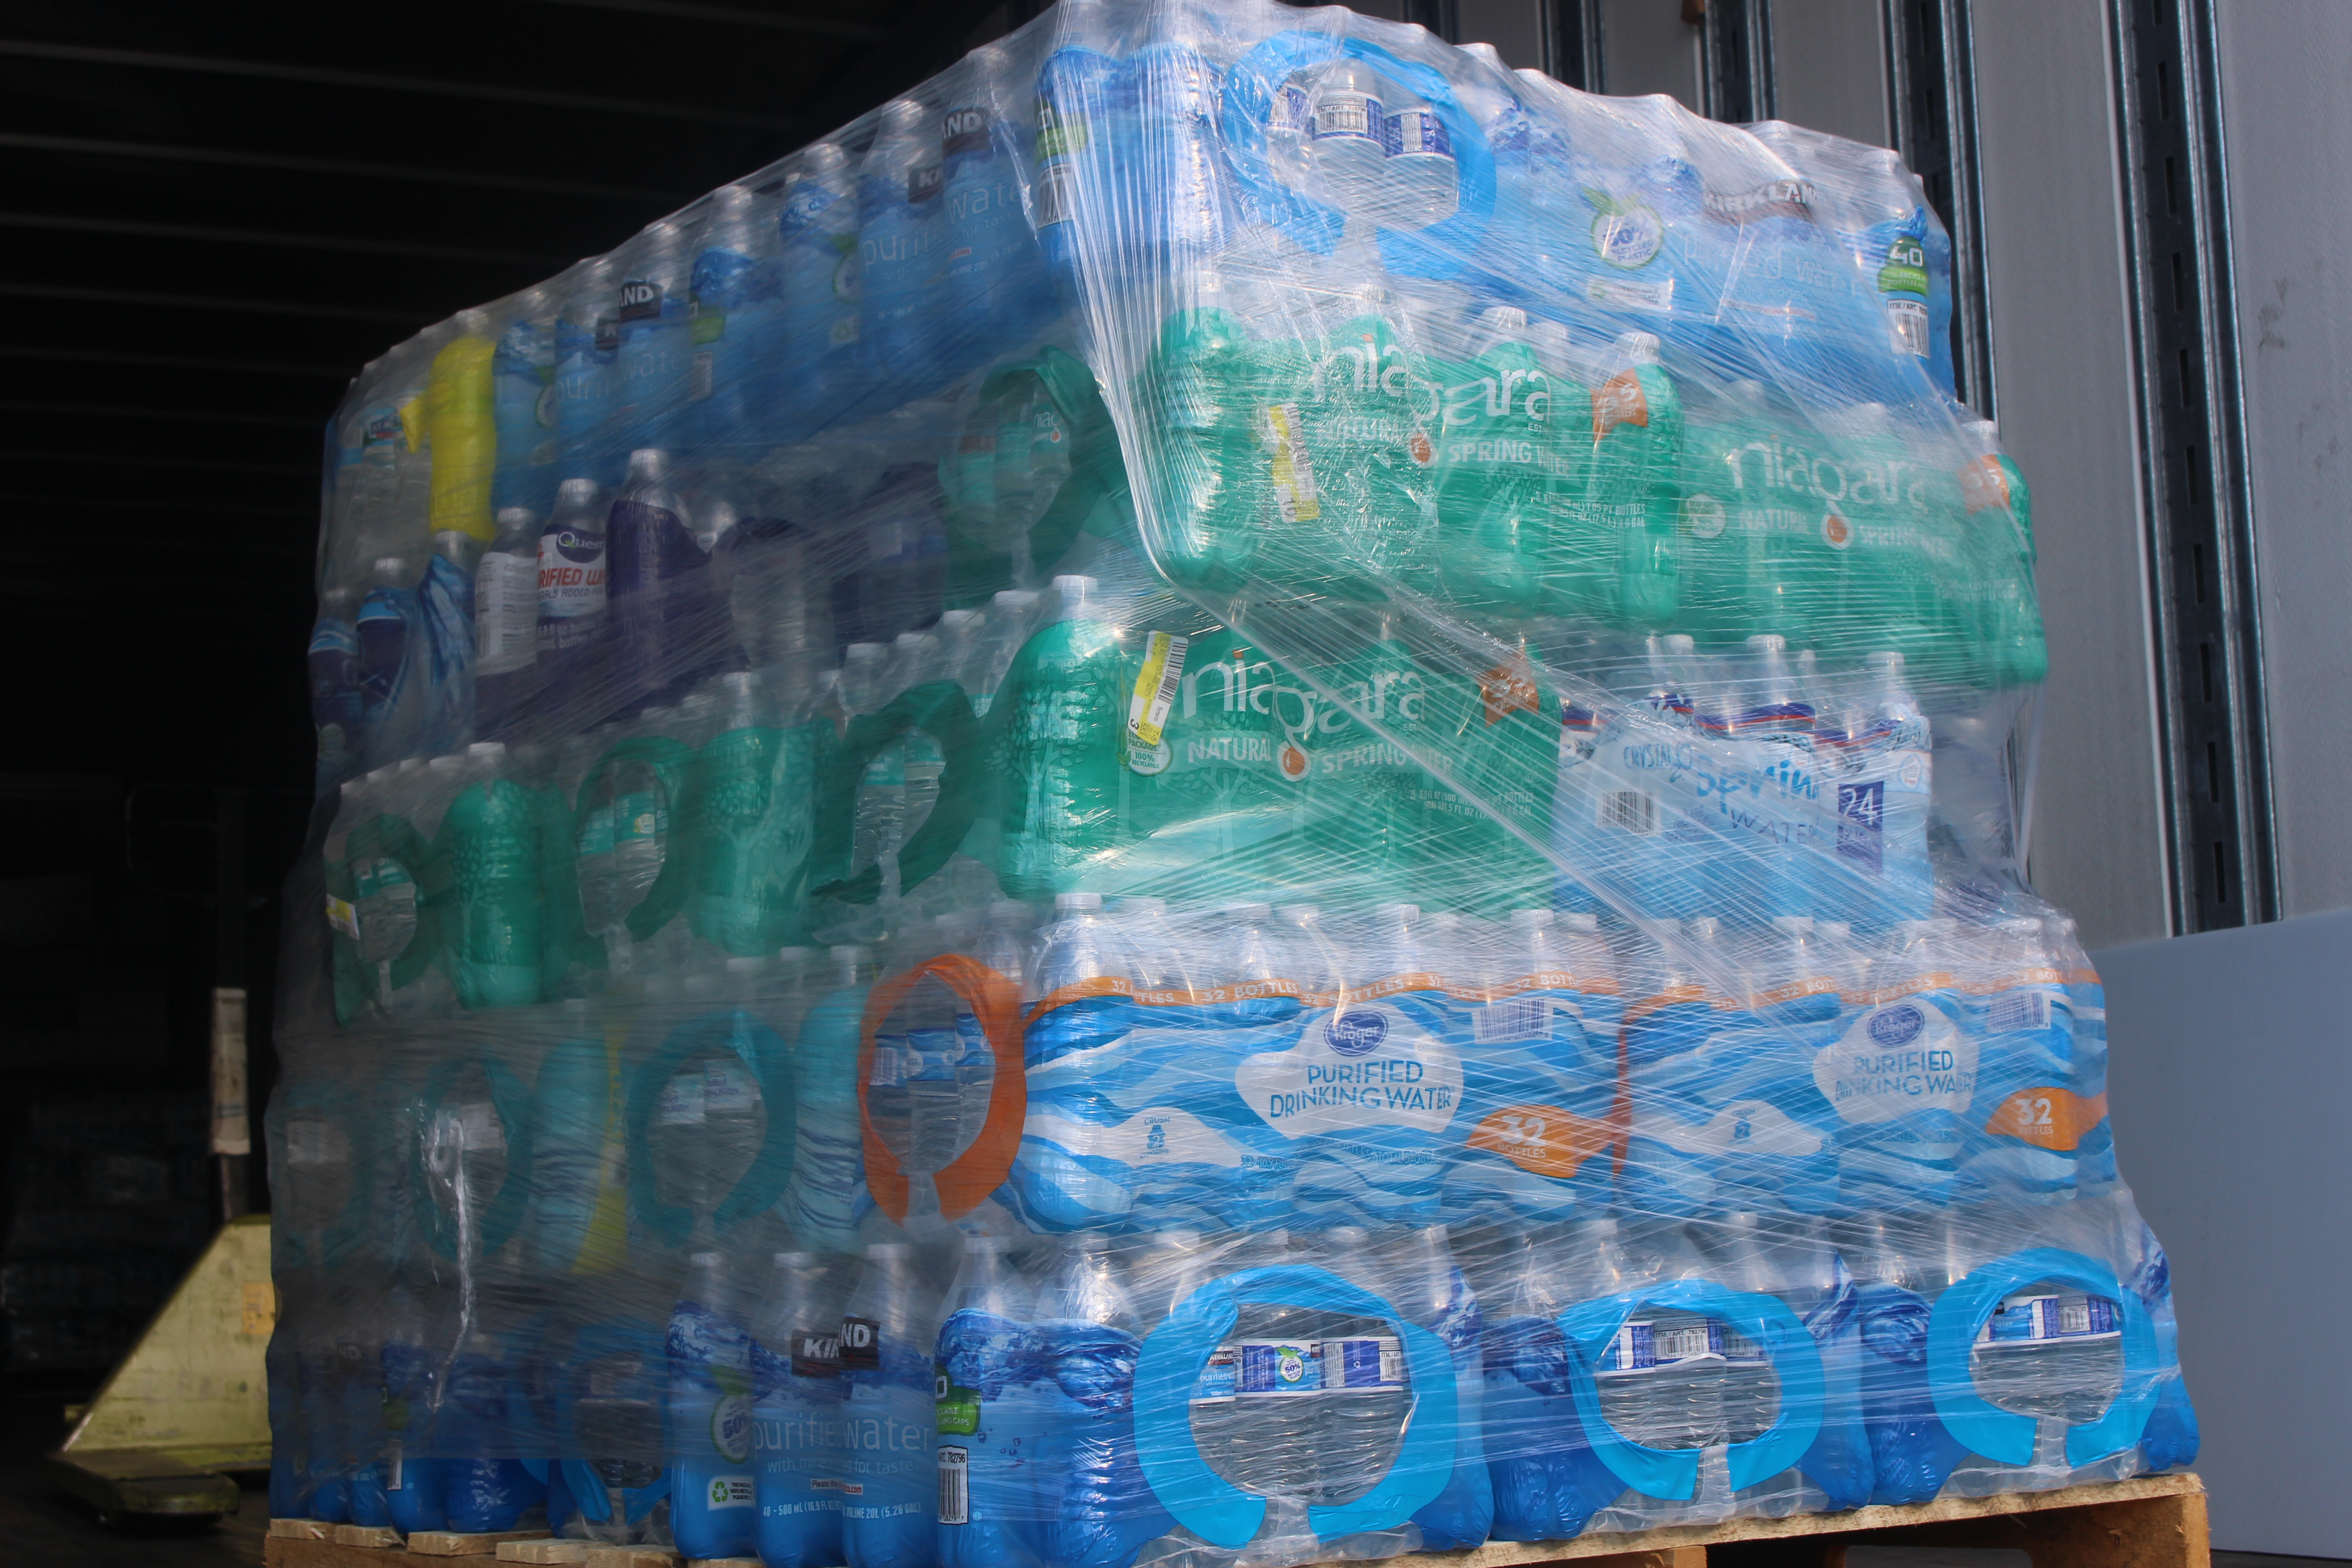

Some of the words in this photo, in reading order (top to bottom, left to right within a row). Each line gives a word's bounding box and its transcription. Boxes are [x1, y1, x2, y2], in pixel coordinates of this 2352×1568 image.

[1890, 245, 1923, 267] 40
[1906, 304, 1916, 312] ART.
[1449, 440, 1532, 465] SPRING
[1603, 504, 1613, 514] PT
[1615, 503, 1646, 516] BOTTLES
[1631, 516, 1645, 528] GAL
[561, 588, 590, 598] ADDED
[1154, 706, 1163, 721] Sysco
[1182, 650, 1426, 768] niagara
[1130, 718, 1140, 730] 3
[1128, 738, 1158, 751] PACKAGE
[1132, 759, 1160, 769] RECYCLABLE
[1135, 751, 1155, 763] 100%
[1322, 742, 1407, 773] SPRING
[1696, 754, 1820, 815] Sprin
[1428, 789, 1434, 799] FL
[1434, 790, 1441, 800] OZ
[1441, 791, 1456, 803] (500
[1504, 791, 1534, 804] BOTTLES
[1424, 800, 1438, 810] TOTAL
[1438, 802, 1453, 813] 591.5
[1454, 805, 1463, 815] FL
[1464, 808, 1474, 818] OZ
[1842, 787, 1878, 826] 24
[1112, 980, 1126, 992] 32
[1203, 990, 1225, 1002] 32
[1234, 981, 1298, 998] BOTTLES
[1428, 975, 1441, 987] 32
[1855, 1050, 1954, 1074] PURIFIED
[1308, 1060, 1424, 1084] PURIFIED
[1270, 1086, 1381, 1118] DRINKING
[1384, 1086, 1452, 1111] WATER
[2014, 1098, 2052, 1126] 32
[1144, 1116, 1171, 1125] CRUSH
[1499, 1116, 1546, 1147] 32
[1140, 1148, 1170, 1159] CONSERVE
[1497, 1143, 1546, 1158] BOTTLES
[1241, 1156, 1253, 1167] 32
[1284, 1362, 1301, 1373] 50%
[1200, 1372, 1229, 1383] purified
[953, 1417, 970, 1426] CAPS
[845, 1416, 930, 1452] water
[947, 1452, 965, 1463] 782796
[767, 1457, 795, 1474] with
[855, 1457, 870, 1474] for
[876, 1458, 914, 1475] taste
[811, 1479, 829, 1489] Please
[762, 1505, 771, 1518] 40
[778, 1504, 793, 1516] 500
[821, 1500, 828, 1511] FL
[866, 1507, 880, 1519] 20L
[881, 1504, 903, 1519] (5.28
[904, 1502, 921, 1514] GAL)
